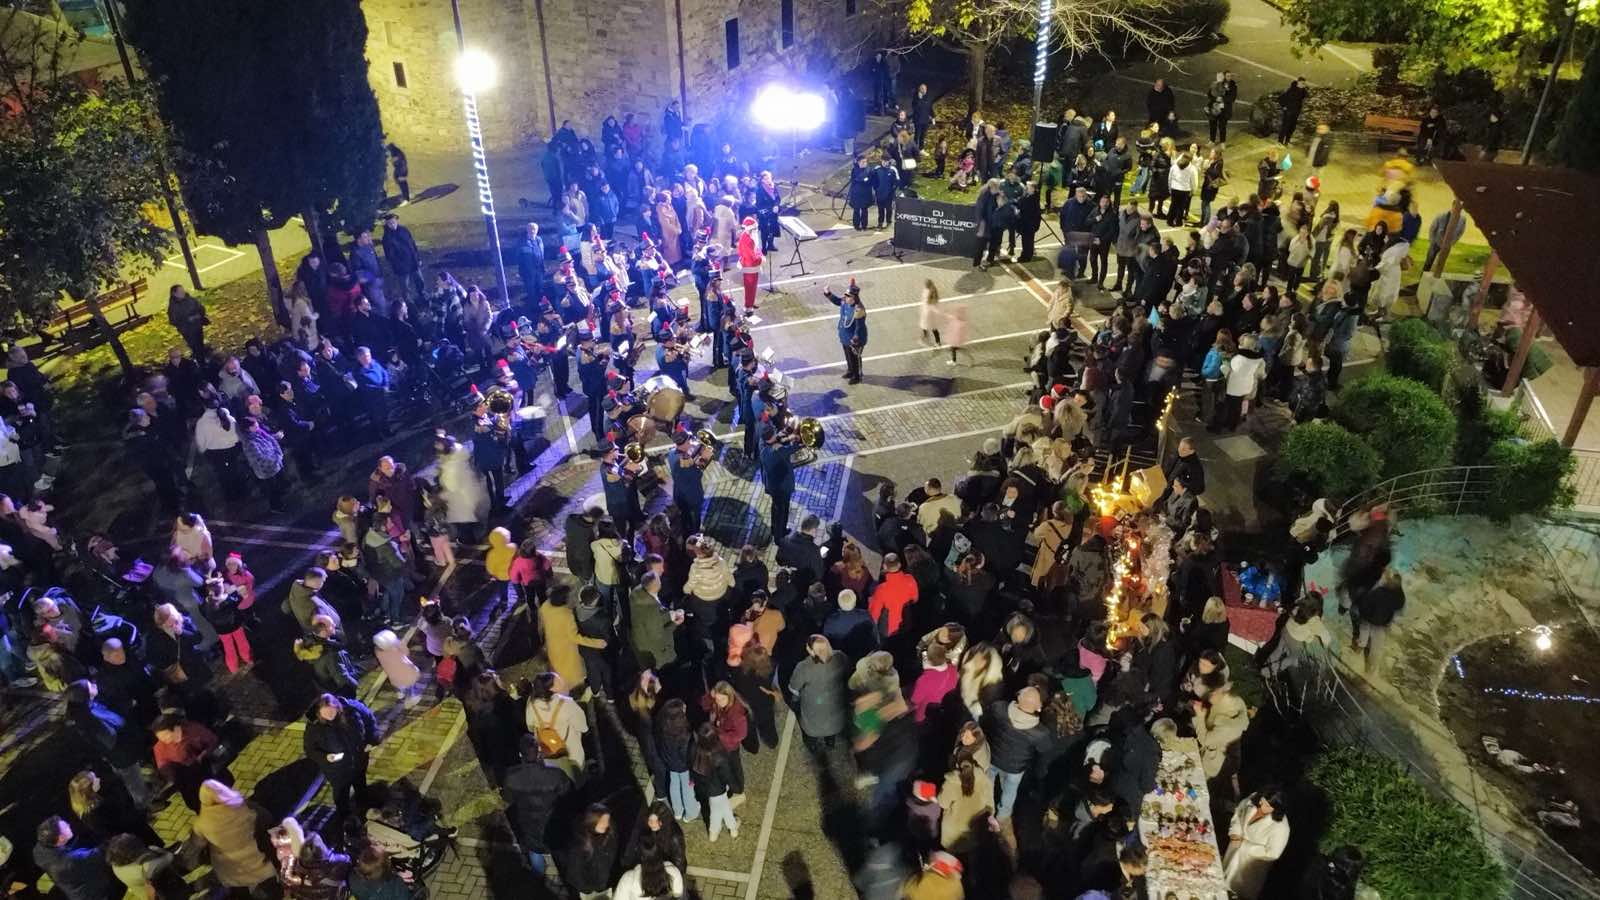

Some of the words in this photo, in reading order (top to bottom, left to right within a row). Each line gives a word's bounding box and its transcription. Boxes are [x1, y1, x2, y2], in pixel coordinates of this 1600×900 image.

[932, 209, 944, 217] DJ
[896, 213, 937, 224] XRISTOS
[940, 219, 976, 228] KOURO
